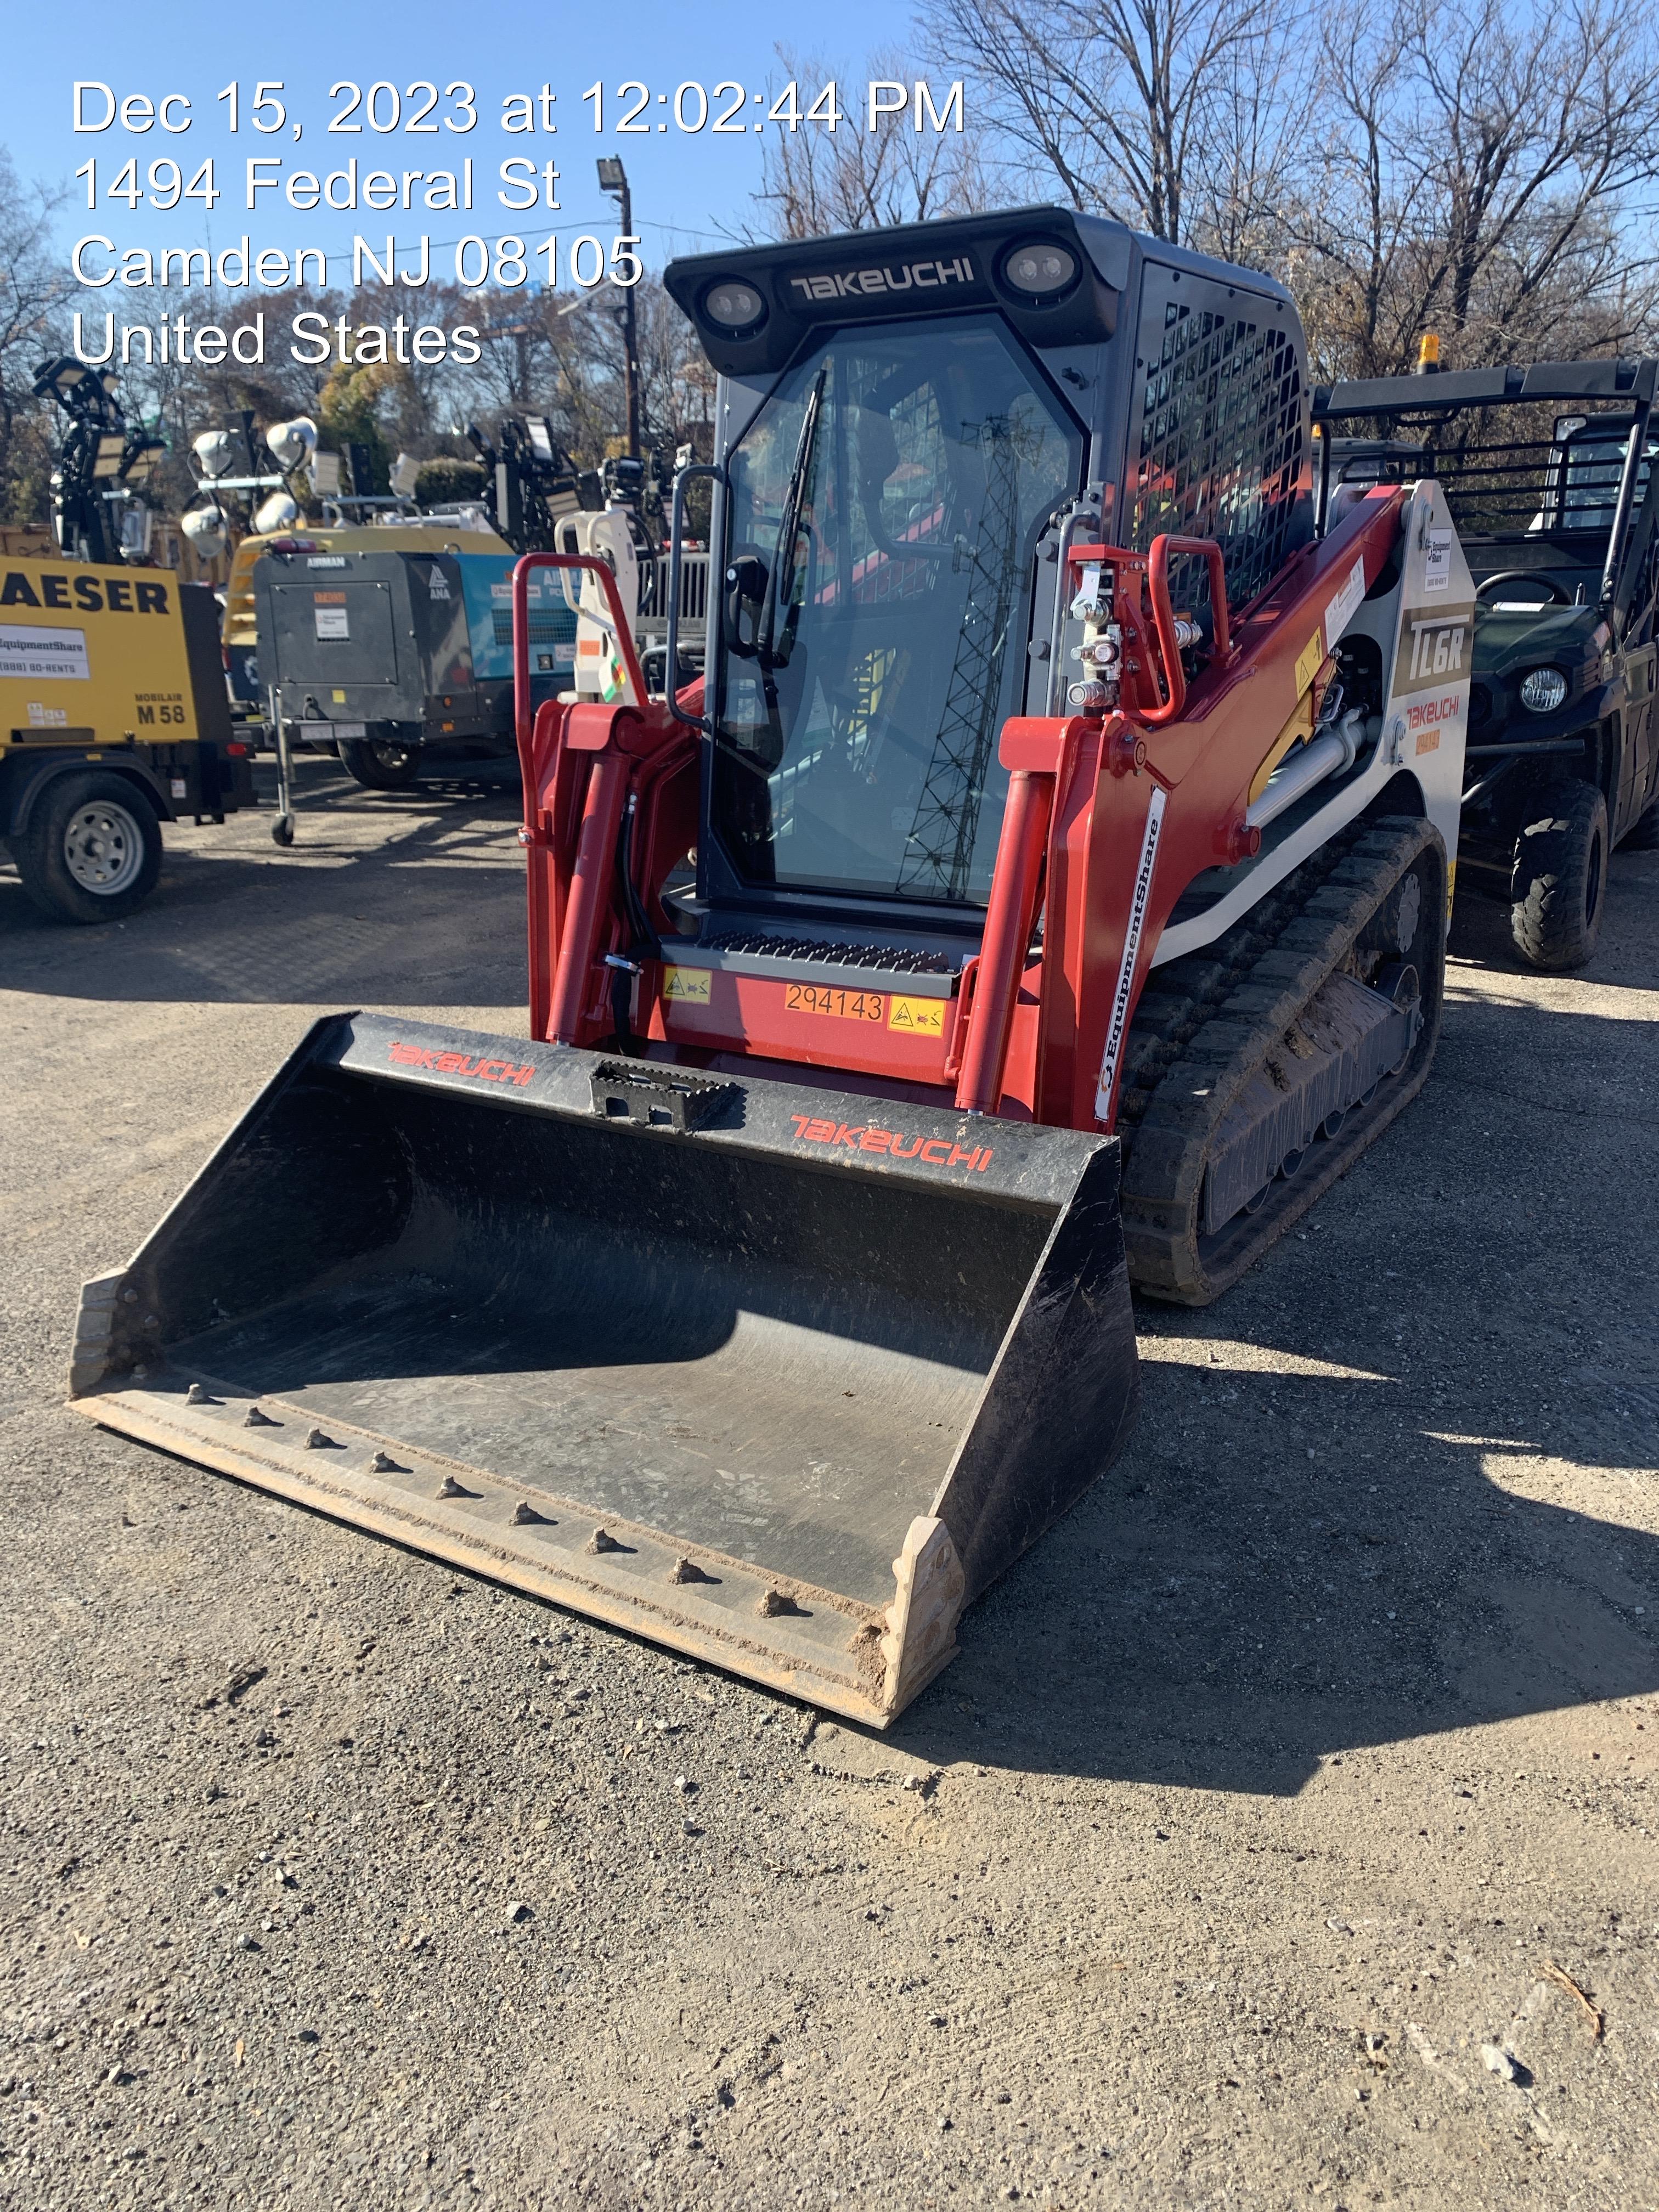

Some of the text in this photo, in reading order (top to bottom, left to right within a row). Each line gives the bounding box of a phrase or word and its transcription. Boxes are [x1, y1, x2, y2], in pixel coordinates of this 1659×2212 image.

[307, 556, 346, 568] AIRMAN
[430, 588, 450, 600] ANA
[1409, 614, 1470, 681] TL6R
[135, 693, 183, 702] MOBILAIR
[137, 705, 185, 725] M 58
[1107, 818, 1158, 1060] EquipmentShare
[787, 985, 883, 1020] 294143
